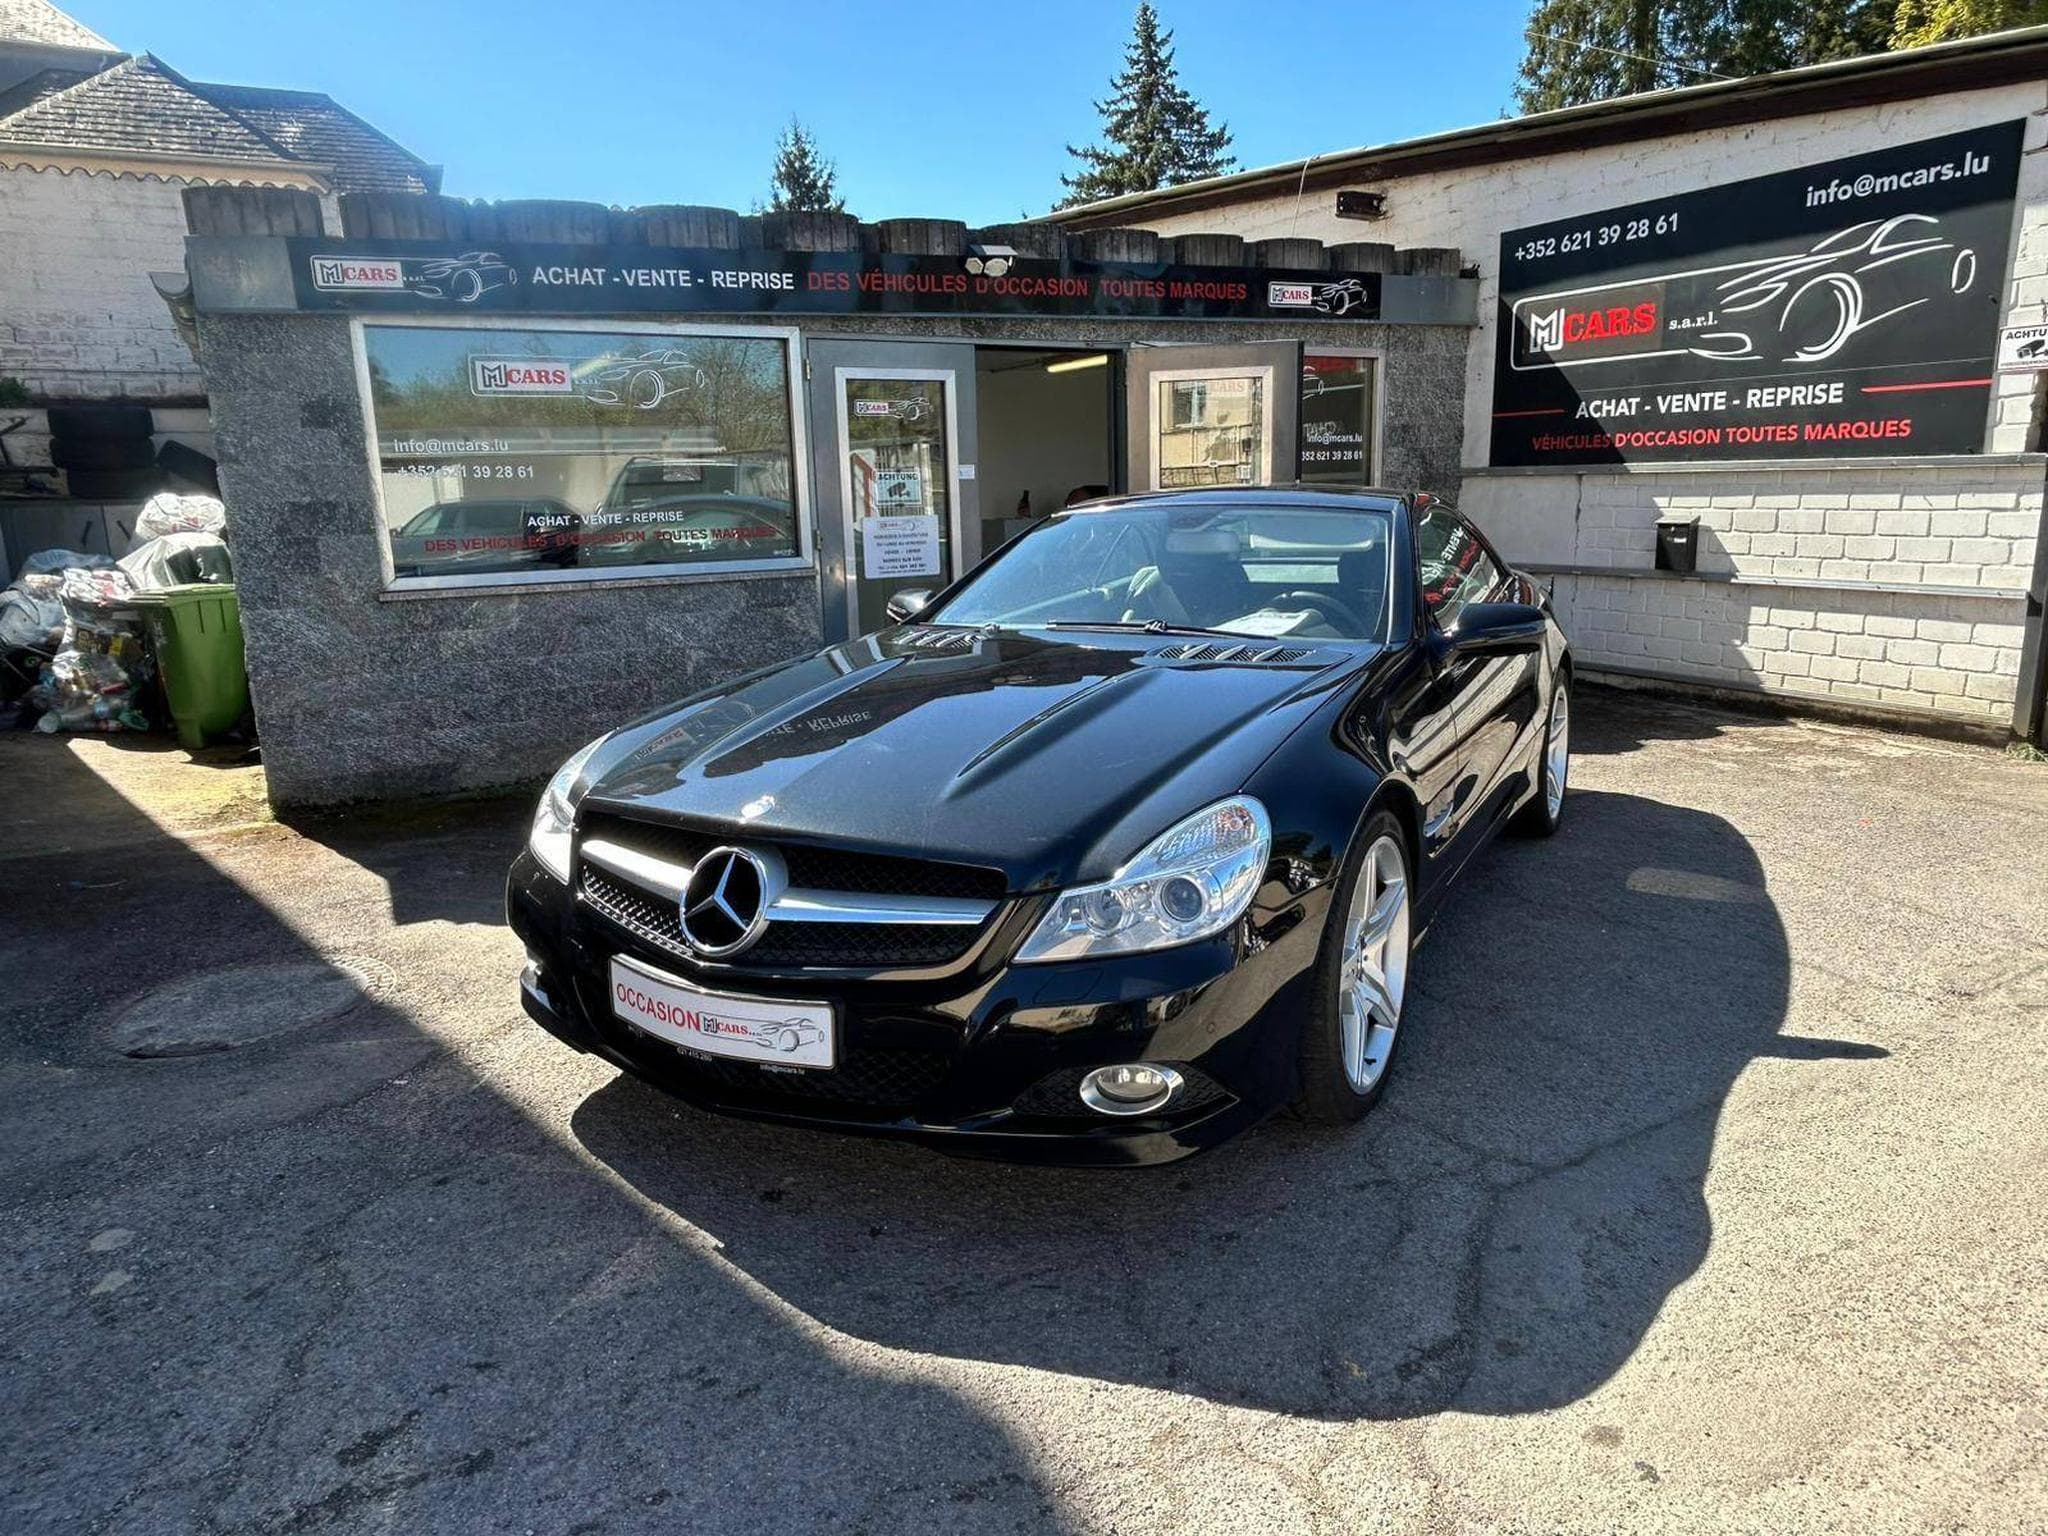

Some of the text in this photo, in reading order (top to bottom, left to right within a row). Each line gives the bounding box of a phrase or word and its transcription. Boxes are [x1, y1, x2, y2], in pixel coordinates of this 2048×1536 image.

[1806, 151, 1990, 207] info@mcars.lu
[1514, 212, 1678, 261] +352 621 39 28 61
[532, 266, 606, 286] ACHAT
[711, 270, 795, 289] REPRISE
[808, 272, 850, 291] DES
[856, 269, 967, 292] VÉHICULES
[975, 276, 1088, 296] D'OCCASION
[1101, 279, 1166, 298] TOUTES
[1169, 280, 1247, 300] MARQUES
[1669, 312, 1718, 330] s.a.r.l.
[2005, 329, 2047, 340] ACHTU
[1575, 396, 1641, 419] ACHAT
[1657, 391, 1727, 414] VENTE
[1746, 383, 1845, 409] REPRISE
[1614, 427, 1720, 448] D'OCCASION
[1725, 424, 1798, 444] TOUTES
[1804, 419, 1912, 441] MARQUES
[394, 438, 509, 454] info@mcars.lu
[472, 465, 491, 478] 39
[495, 465, 514, 478] 28
[517, 465, 534, 478] 61
[527, 515, 571, 527] ACHAT
[582, 513, 622, 526] VENTE
[633, 511, 685, 523] REPRISE
[425, 539, 457, 552] DES
[617, 983, 701, 1031] OCCASION
